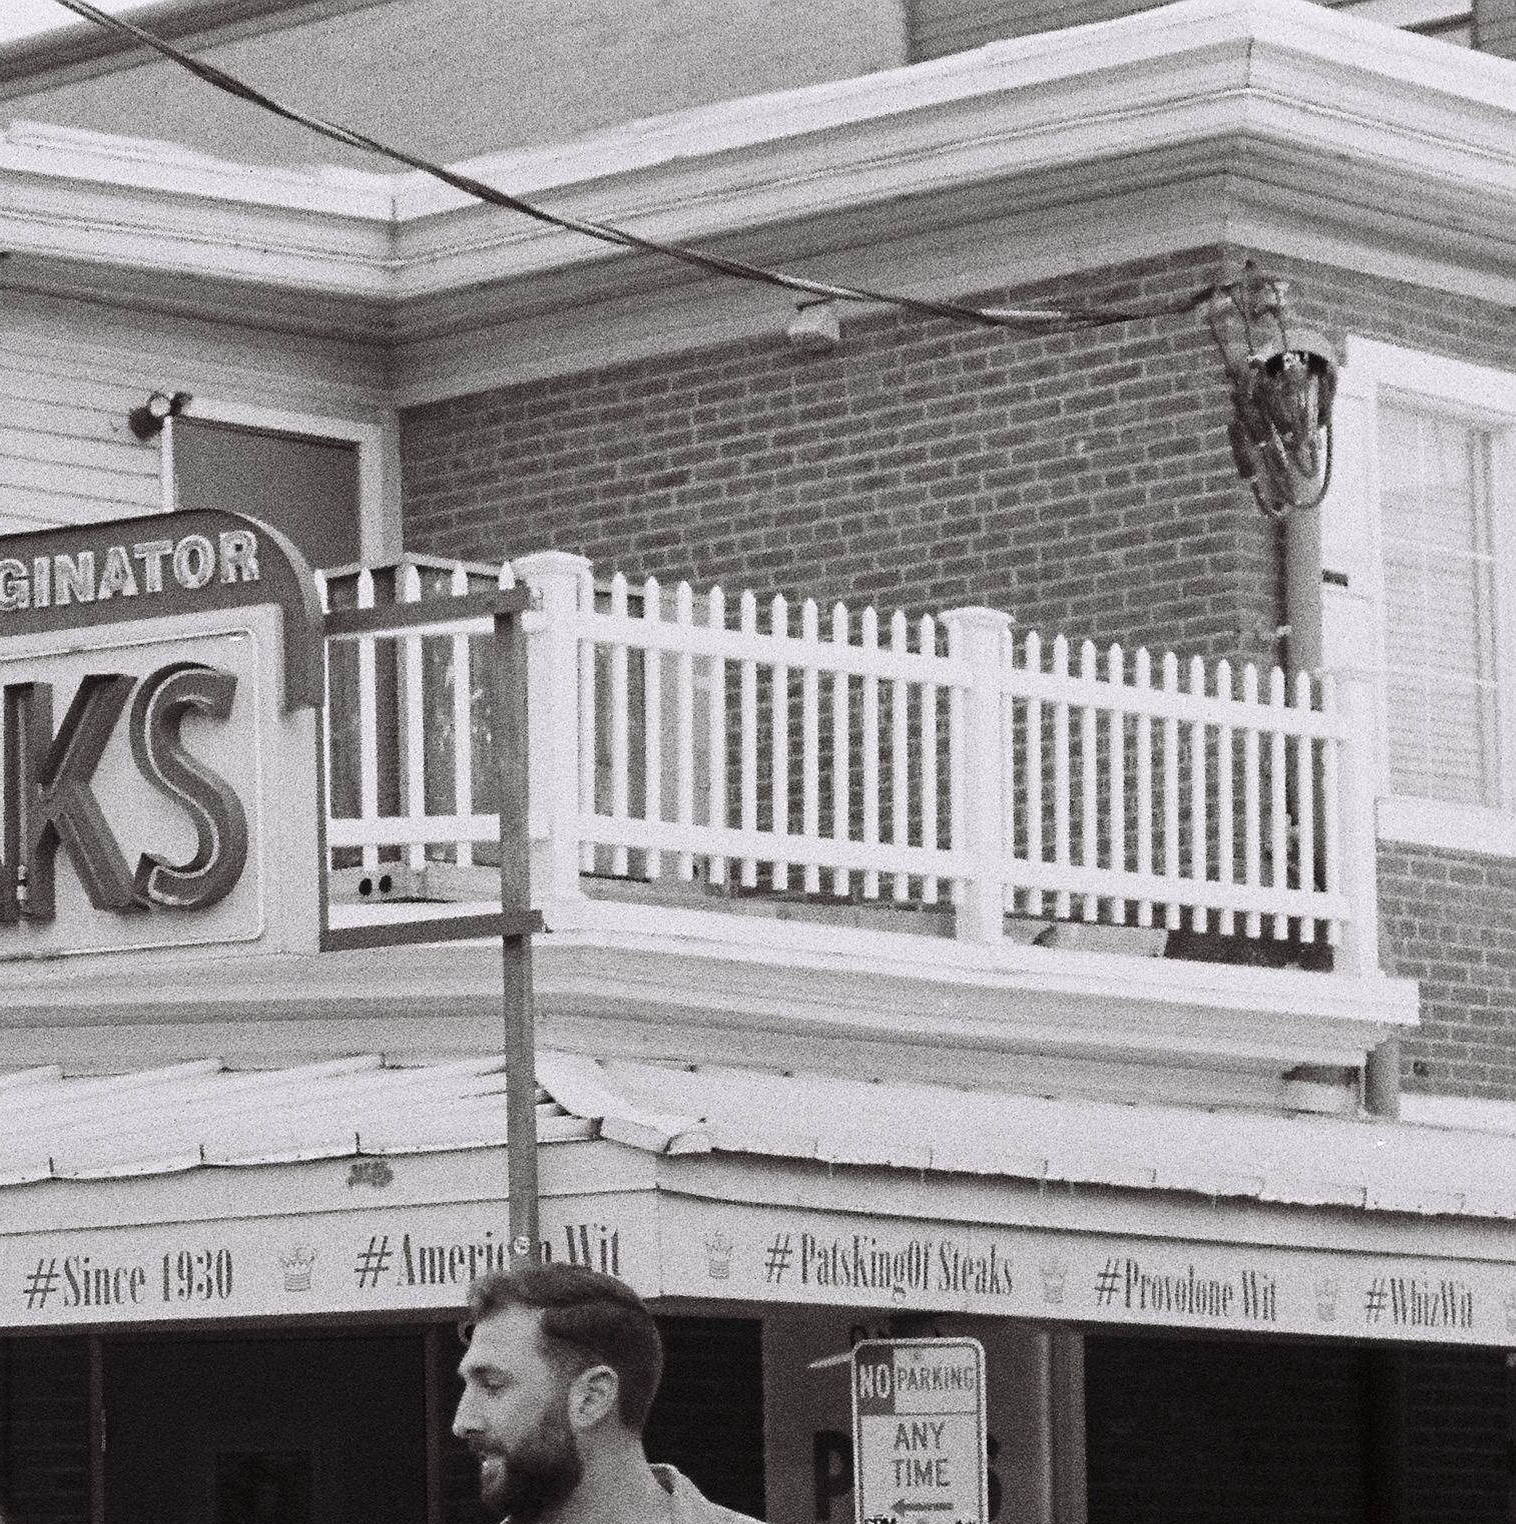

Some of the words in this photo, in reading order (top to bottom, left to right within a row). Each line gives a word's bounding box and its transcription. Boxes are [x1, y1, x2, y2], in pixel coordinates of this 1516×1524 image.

[354, 1233, 553, 1288] #Americn
[22, 1255, 147, 1311] #Since
[160, 1248, 234, 1302] 1930
[858, 1363, 891, 1400] NO
[896, 1366, 975, 1392] PARKING
[893, 1421, 946, 1451] ANY
[891, 1458, 951, 1488] TIME
